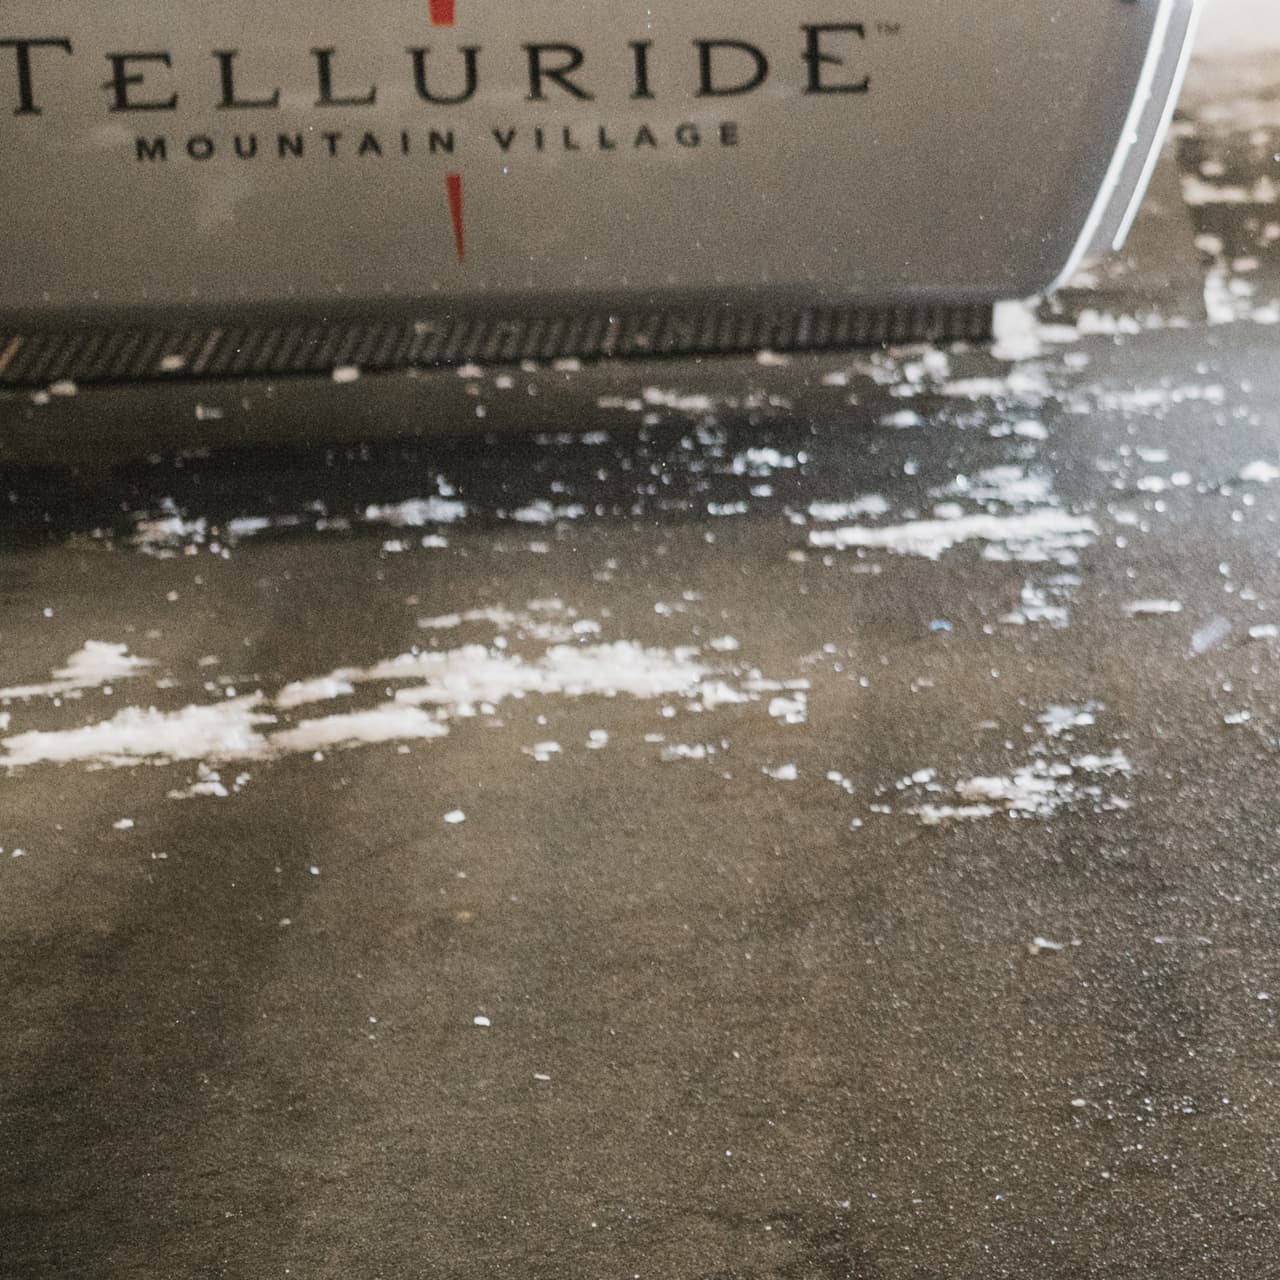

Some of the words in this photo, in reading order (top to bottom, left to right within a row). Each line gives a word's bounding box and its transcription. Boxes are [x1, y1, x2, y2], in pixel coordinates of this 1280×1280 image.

[0, 22, 870, 117] TELLURIDE
[135, 126, 454, 162] MOUNTAIN
[490, 121, 738, 151] VILLAGE
